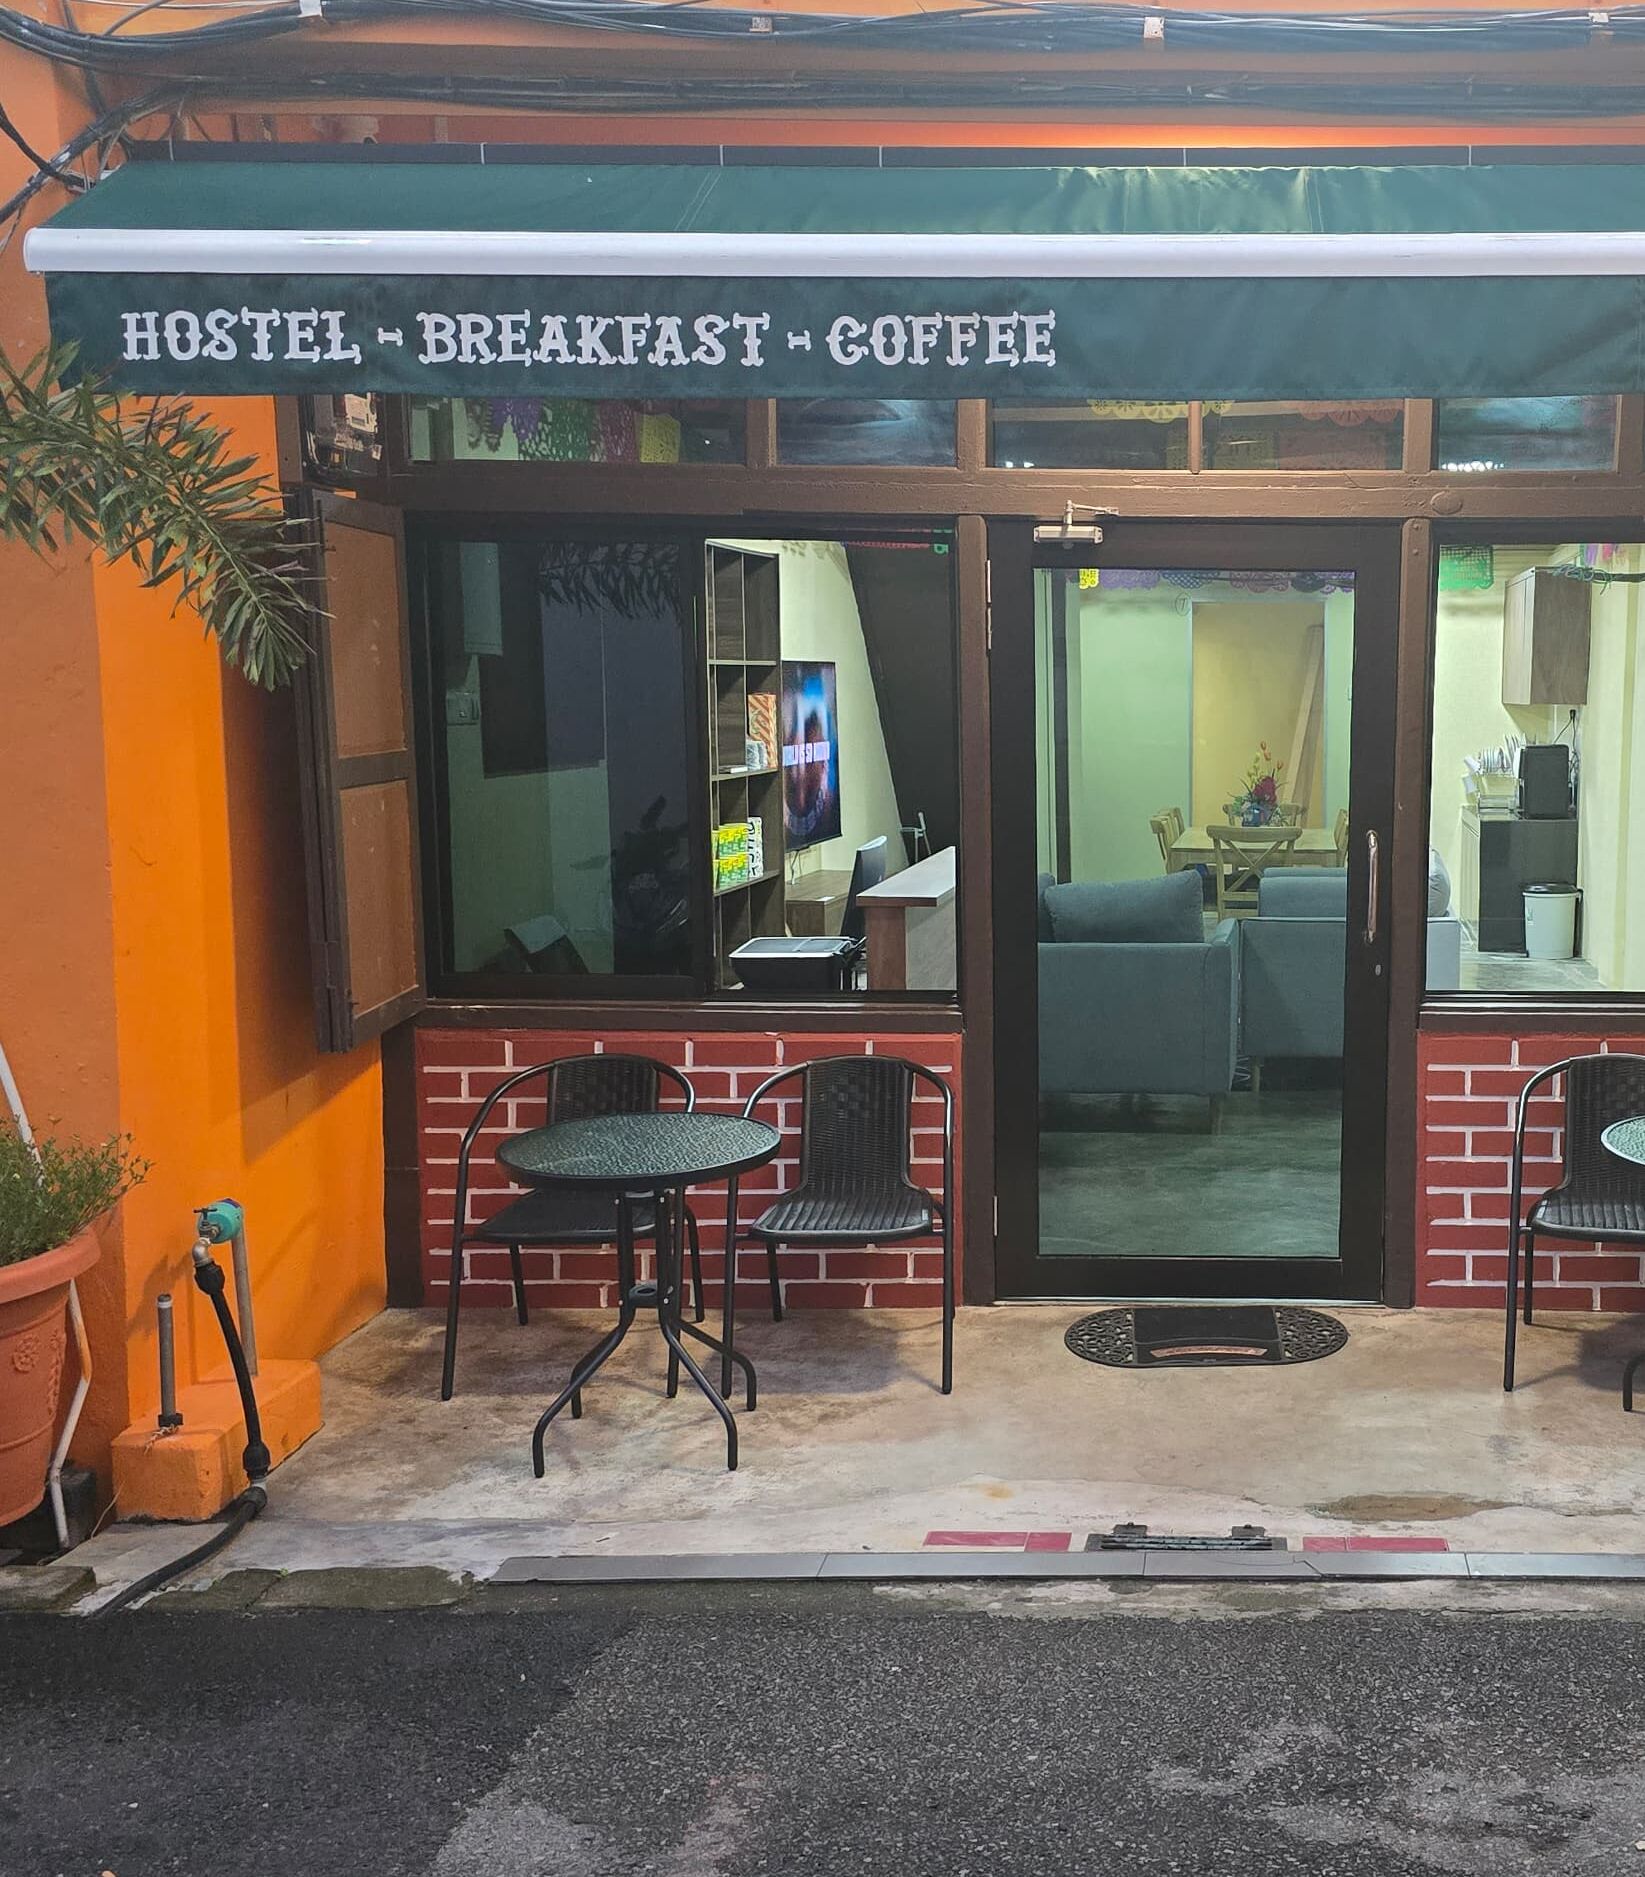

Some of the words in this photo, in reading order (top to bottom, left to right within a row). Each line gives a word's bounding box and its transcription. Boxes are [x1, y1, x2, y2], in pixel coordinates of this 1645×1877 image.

[120, 306, 362, 365] HOSTEL
[415, 308, 771, 368] BREAKFAST
[825, 309, 1057, 368] COFFEE
